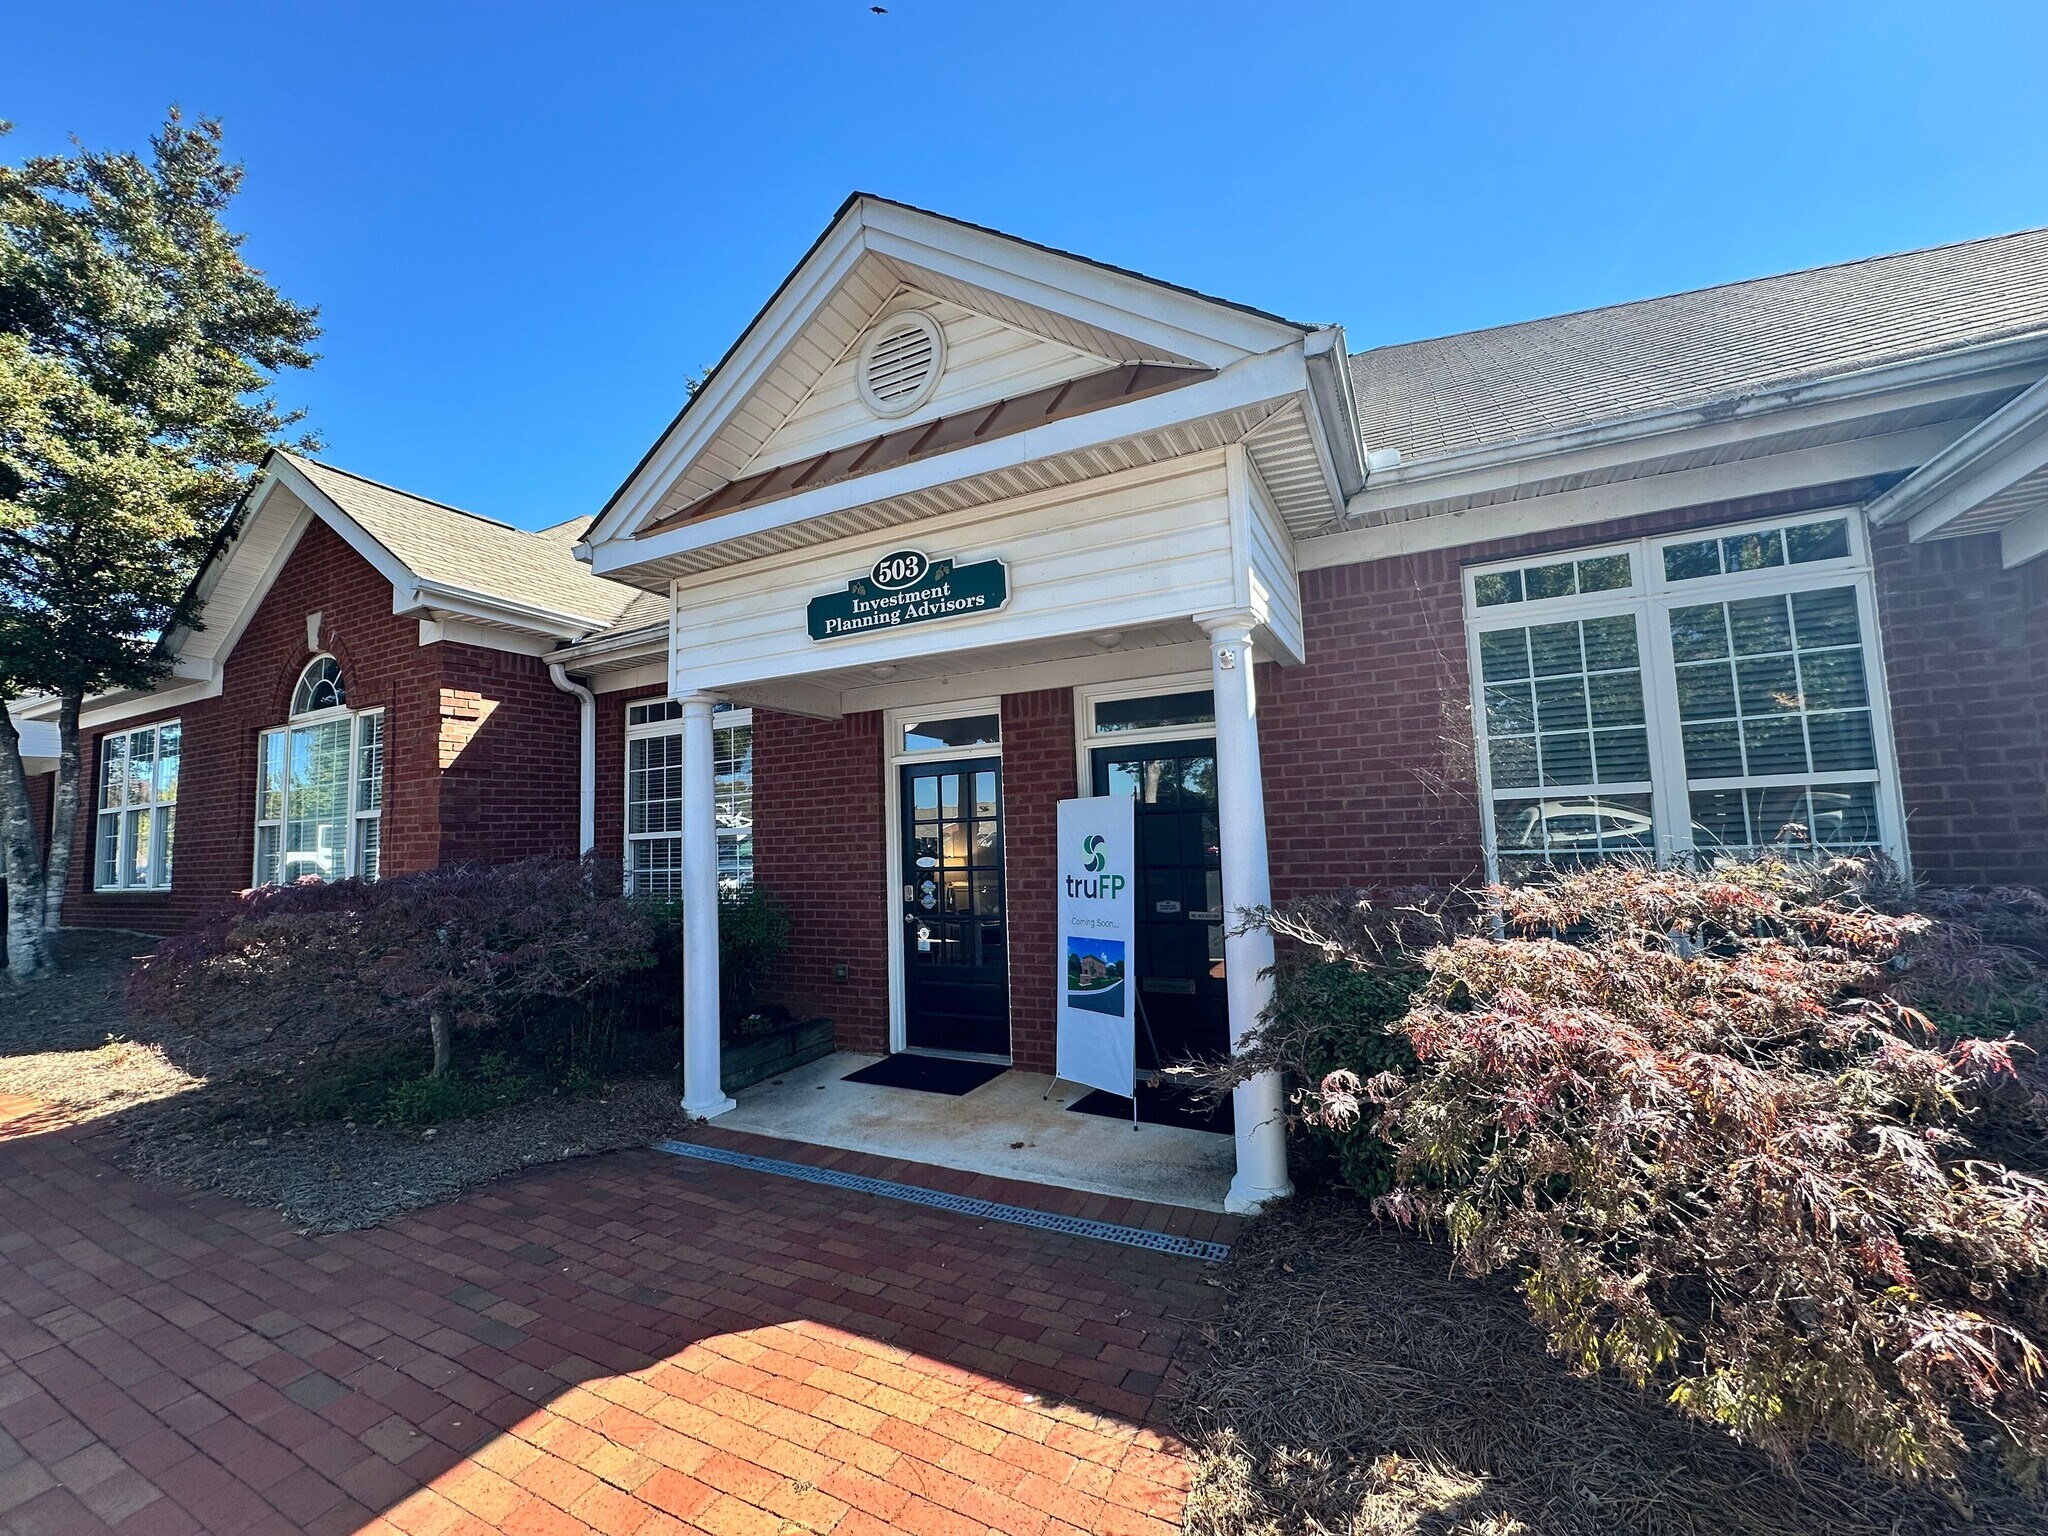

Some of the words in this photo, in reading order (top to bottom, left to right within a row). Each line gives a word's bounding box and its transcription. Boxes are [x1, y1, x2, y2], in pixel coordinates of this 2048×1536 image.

[878, 555, 919, 583] 503
[852, 582, 951, 614] Investment
[825, 609, 900, 634] Planning
[904, 594, 985, 619] Advisors
[1065, 874, 1125, 900] truFP
[1071, 917, 1095, 928] Coming
